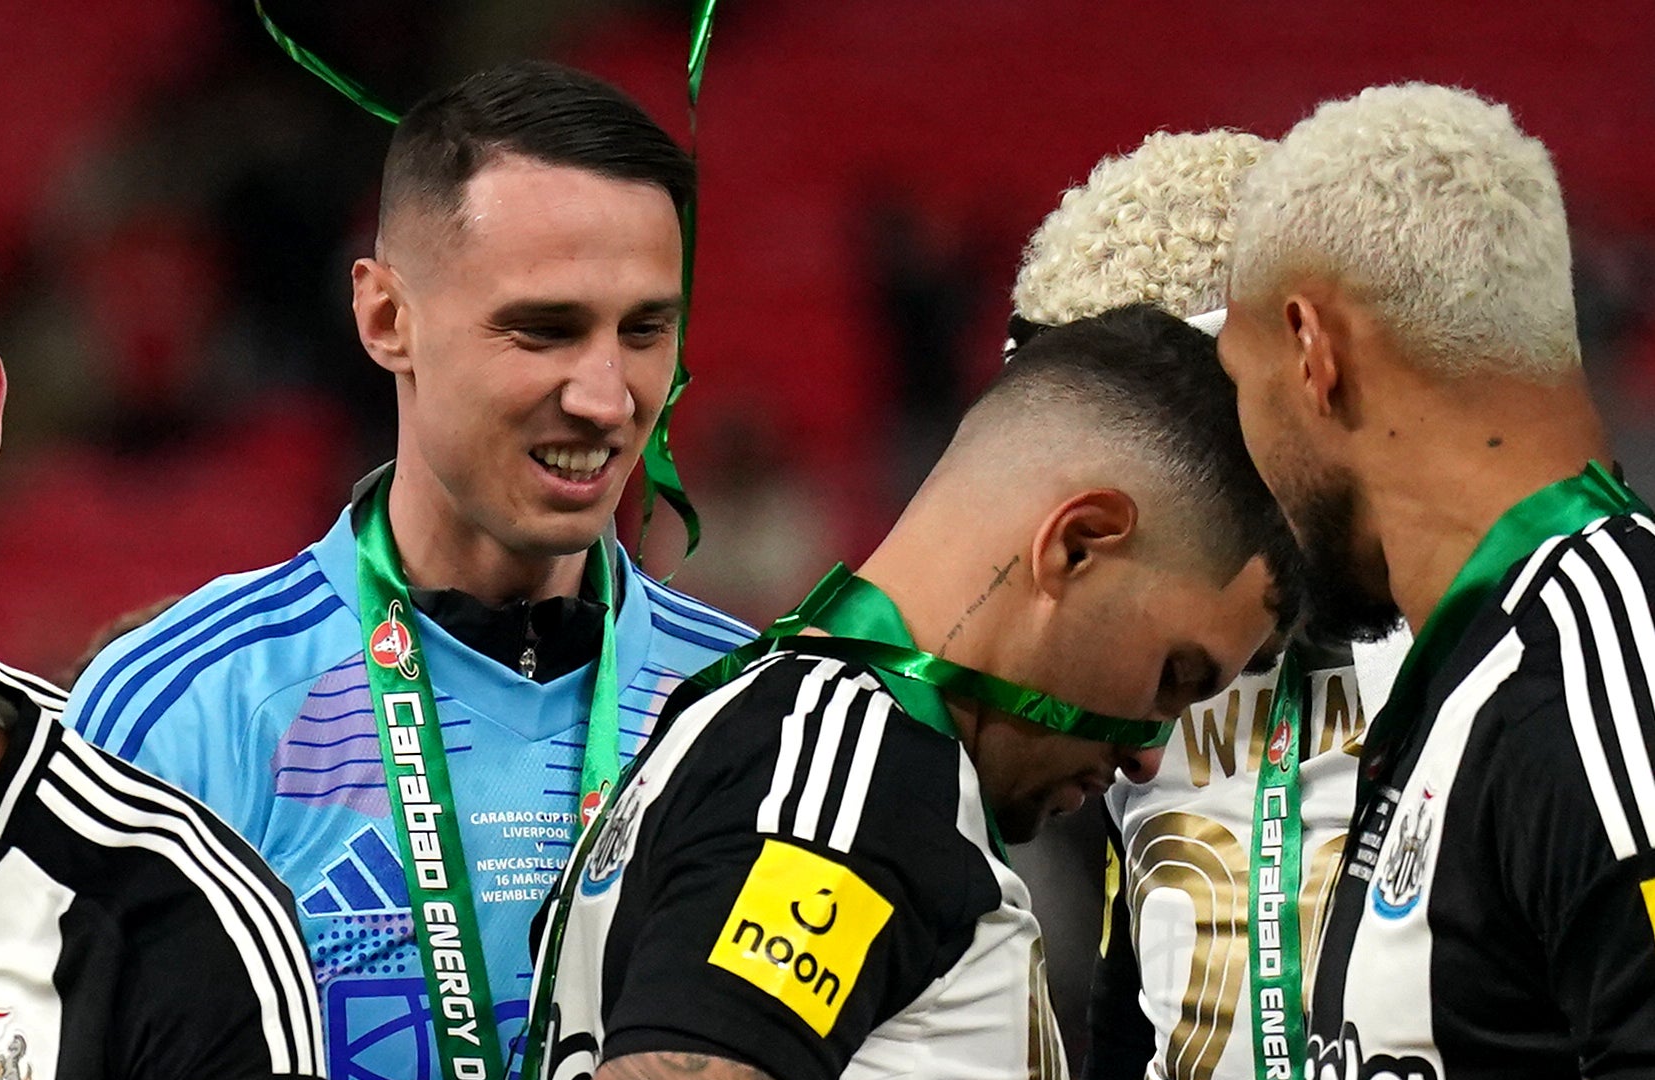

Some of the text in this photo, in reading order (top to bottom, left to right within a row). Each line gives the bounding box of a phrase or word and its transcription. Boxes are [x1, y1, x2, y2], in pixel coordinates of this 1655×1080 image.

[470, 811, 534, 825] CARABAO
[535, 811, 561, 823] CUP
[502, 827, 571, 839] LIVERPOOL
[535, 842, 545, 853] V
[382, 692, 448, 890] Carabao
[423, 901, 480, 1047] ENERGY
[476, 858, 554, 872] NEWCASTLE
[495, 874, 558, 886] 16 MARCH
[1258, 786, 1289, 978] Carabao
[481, 889, 545, 903] WEMBLEY
[732, 919, 840, 1007] noon
